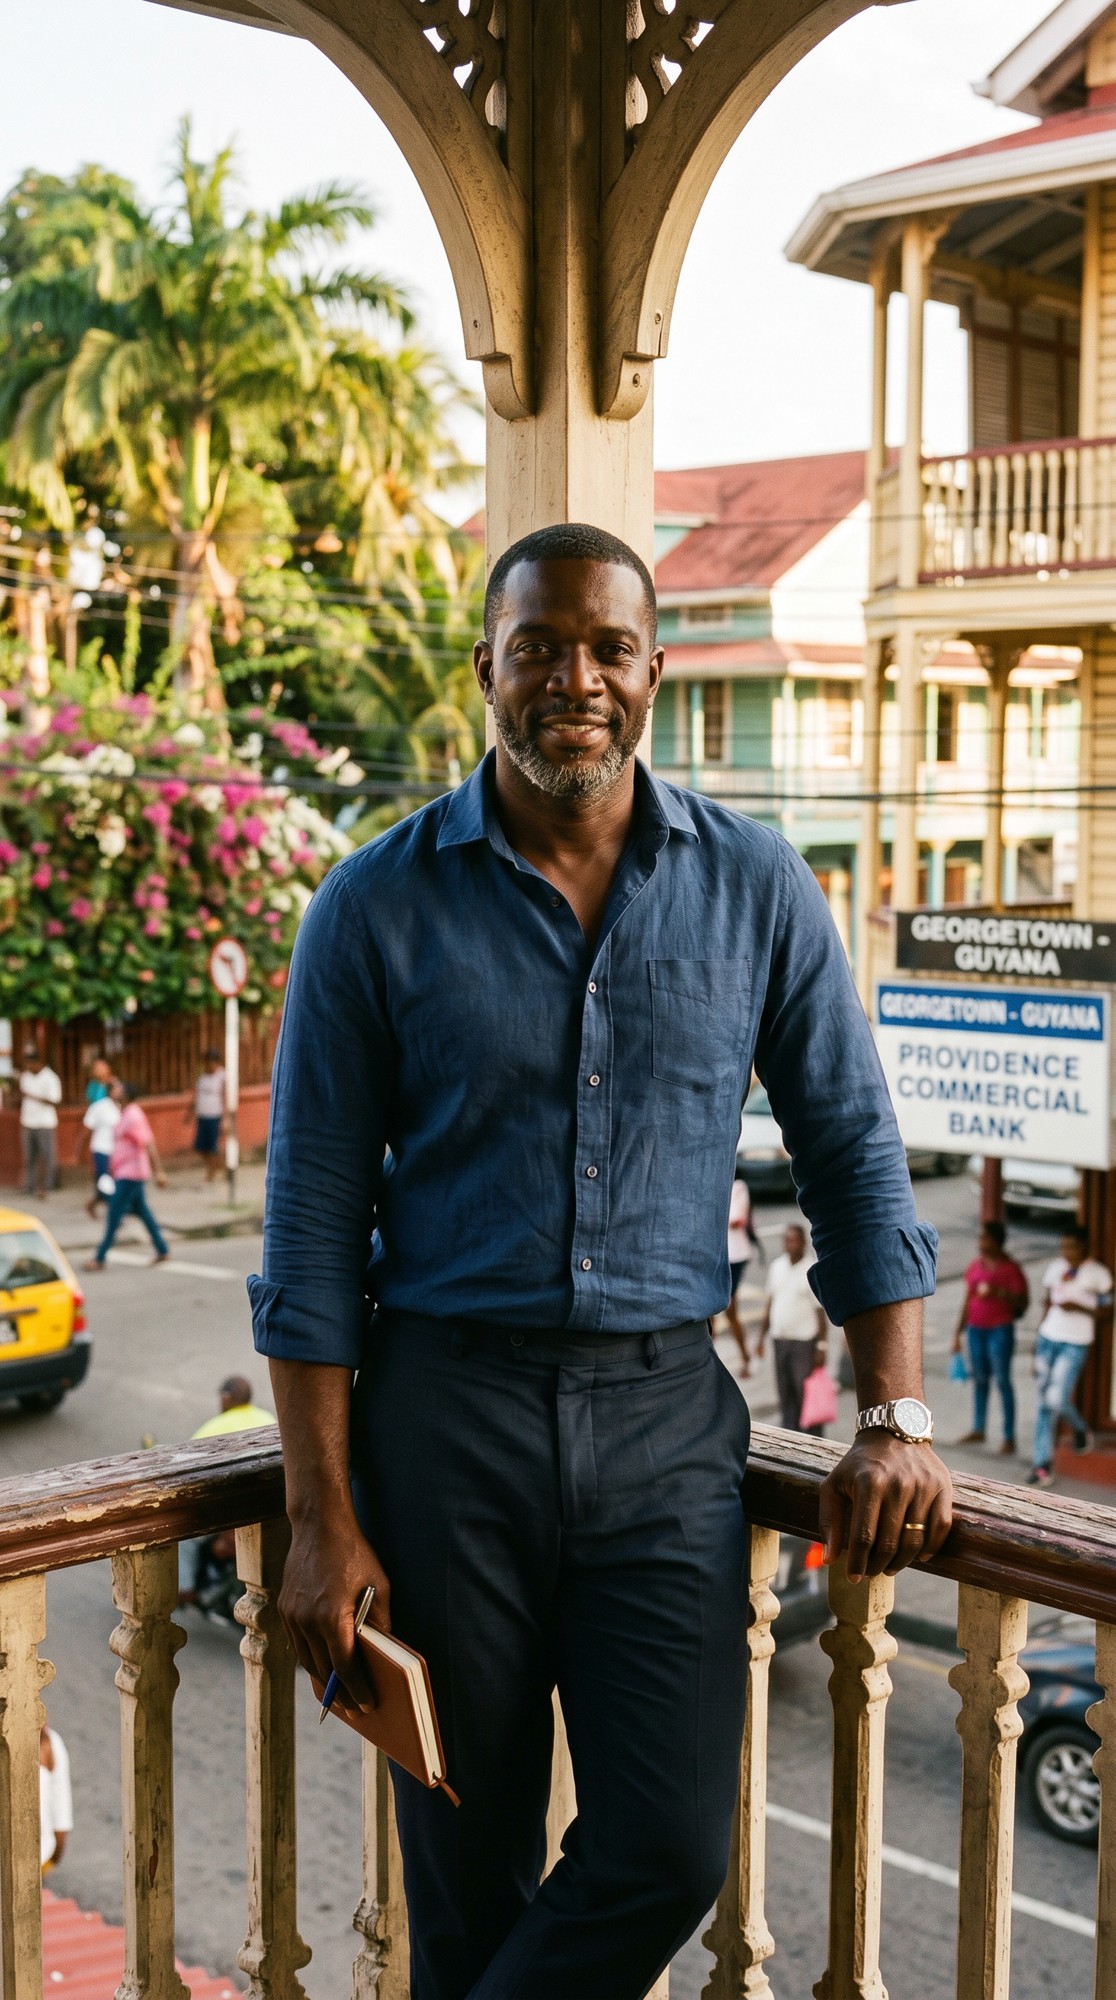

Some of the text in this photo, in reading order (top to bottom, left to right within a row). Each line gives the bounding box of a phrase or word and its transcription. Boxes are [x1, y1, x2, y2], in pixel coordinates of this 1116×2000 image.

[911, 914, 1093, 949] GEORGETOWN
[954, 945, 1061, 976] GUYANA
[880, 992, 1007, 1025] GEORGETOWN
[1020, 1002, 1101, 1032] GUYANA
[899, 1043, 1080, 1080] PROVIDENCE
[897, 1076, 1089, 1115] COMMERCIAL
[949, 1112, 1026, 1141] BANK
